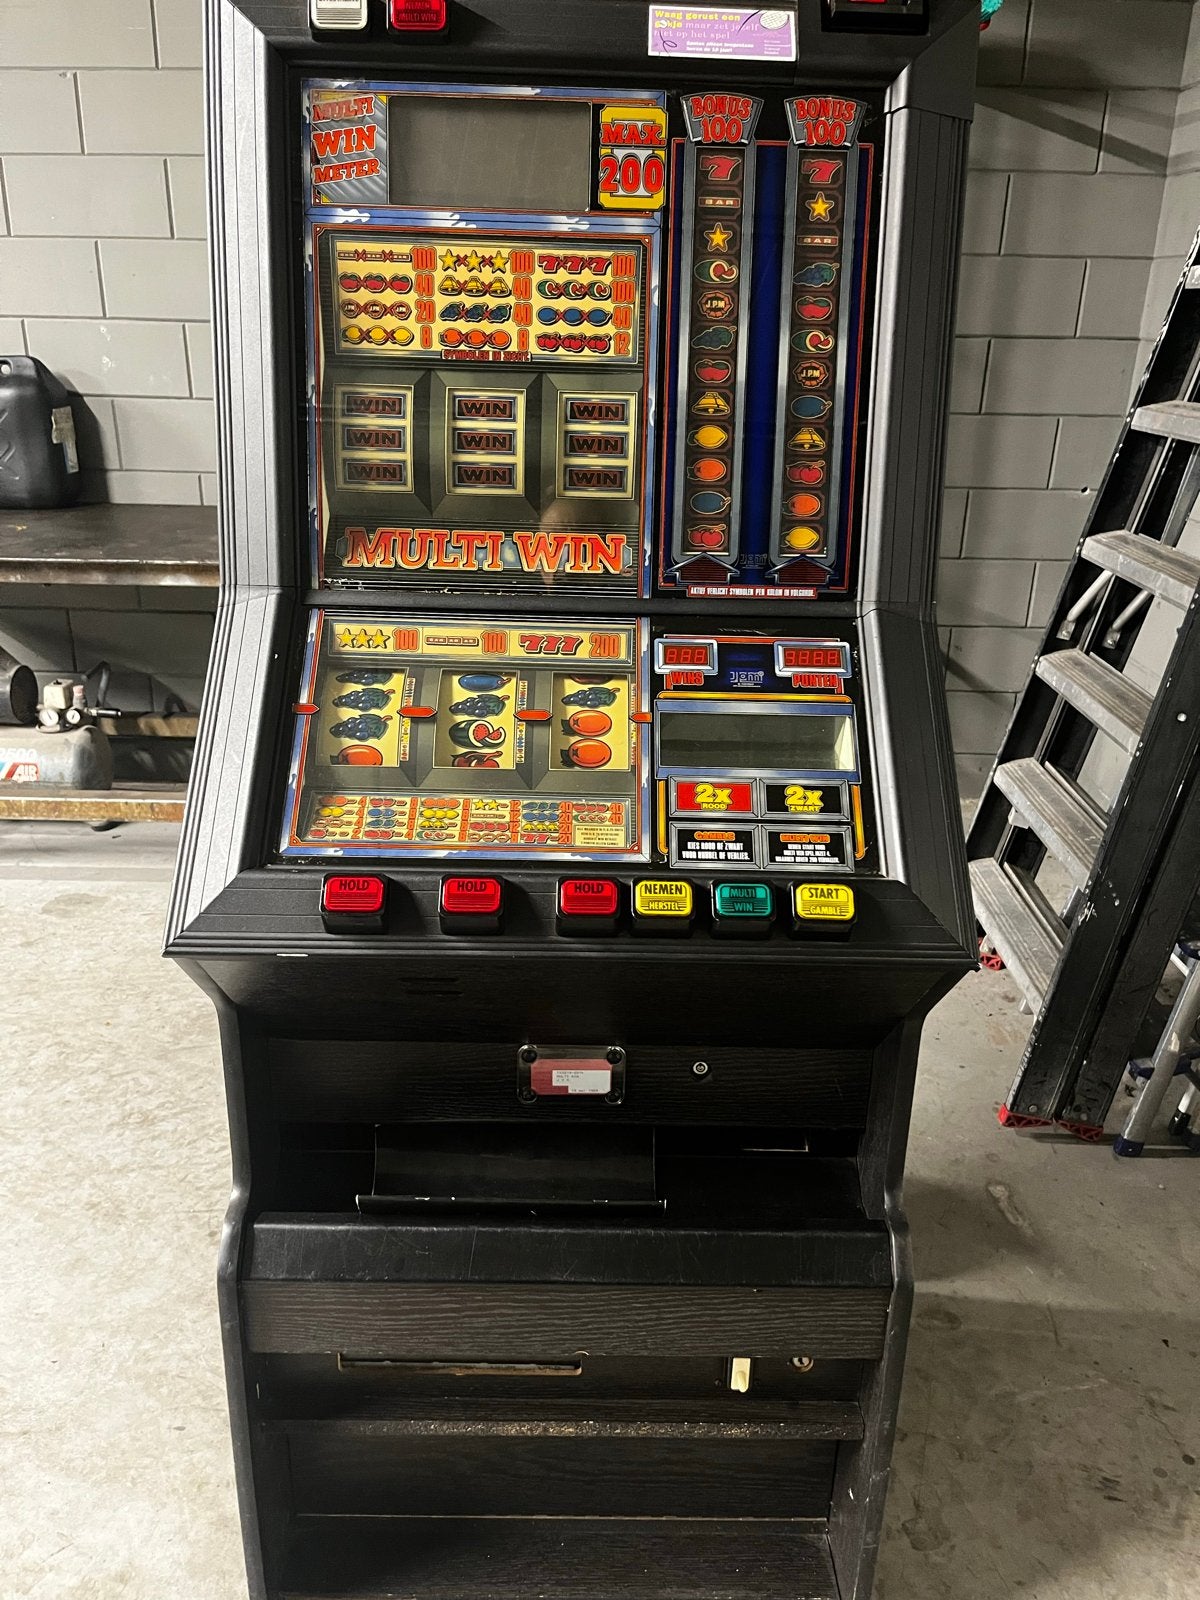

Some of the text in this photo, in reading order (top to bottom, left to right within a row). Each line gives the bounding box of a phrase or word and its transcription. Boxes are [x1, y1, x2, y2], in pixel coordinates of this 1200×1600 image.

[312, 96, 374, 122] MULTI
[690, 95, 752, 120] BONUS
[794, 99, 856, 124] BONUS
[701, 117, 742, 143] 100
[805, 119, 847, 146] 100
[312, 124, 377, 158] WIN
[312, 158, 381, 184] METER
[600, 155, 665, 194] 200
[410, 246, 437, 272] 100
[509, 250, 535, 275] 100
[611, 253, 636, 278] 100
[414, 273, 435, 297] 40
[512, 275, 532, 300] 40
[610, 279, 635, 304] 100
[415, 299, 436, 324] 20
[354, 399, 397, 413] WIN
[463, 402, 507, 416] WIN
[575, 404, 620, 418] WIN
[353, 431, 396, 445] WIN
[462, 434, 507, 448] WIN
[575, 438, 619, 452] WIN
[354, 465, 397, 479] WIN
[463, 468, 507, 482] WIN
[575, 471, 618, 485] WIN
[342, 527, 627, 574] MULTI WIN
[392, 628, 419, 651] 100
[481, 630, 508, 654] 100
[589, 632, 620, 658] 200
[671, 670, 704, 686] WINS
[792, 673, 838, 689] PUNTEN
[559, 801, 572, 812] 40
[609, 803, 624, 813] 40
[701, 802, 727, 810] ROOD
[789, 804, 820, 813] ZWART
[559, 812, 572, 823] 20
[608, 814, 624, 825] 40
[339, 879, 370, 891] HOLD
[457, 881, 487, 893] HOLD
[574, 882, 604, 894] HOLD
[644, 883, 683, 895] NEMEN
[730, 888, 755, 898] MULTI
[808, 887, 840, 899] START
[649, 902, 679, 911] HERSTEL
[734, 902, 753, 912] WIN
[810, 905, 841, 915] GAMBLE
